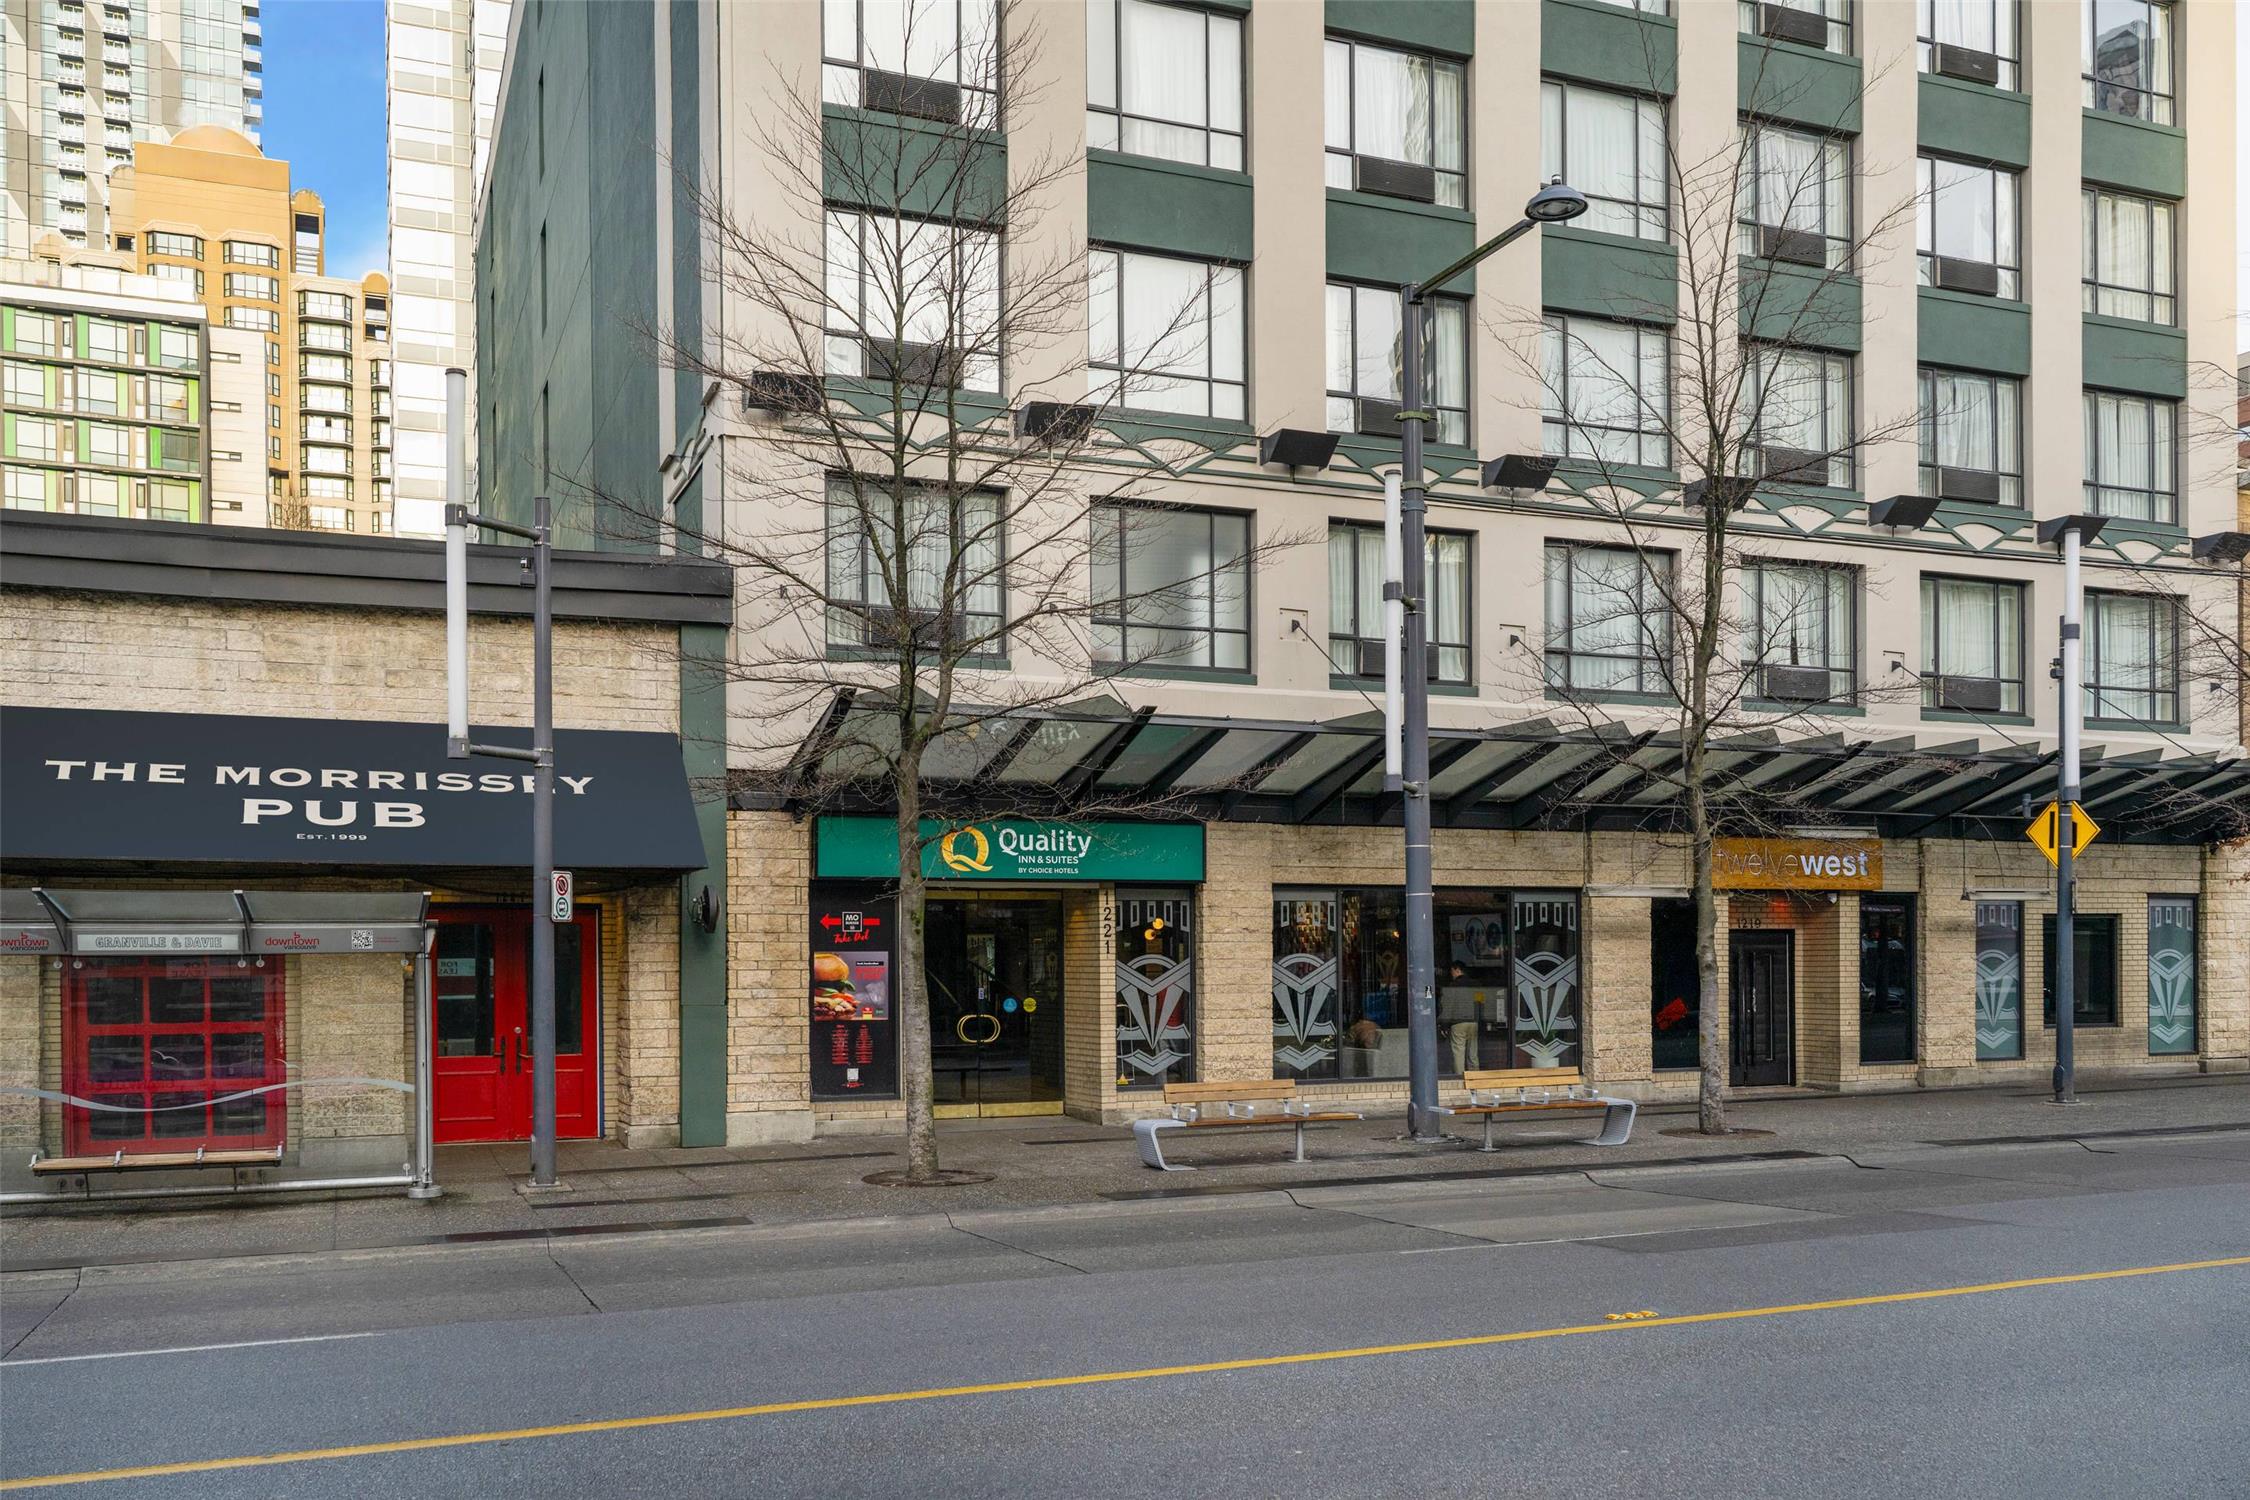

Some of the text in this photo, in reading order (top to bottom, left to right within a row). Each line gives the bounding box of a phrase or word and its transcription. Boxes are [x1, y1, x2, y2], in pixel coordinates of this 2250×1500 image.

[45, 760, 186, 784] THE
[240, 798, 426, 828] PUB
[998, 828, 1092, 858] Quality
[1018, 855, 1079, 865] INN & SUITES
[1028, 867, 1053, 875] CHOICE
[1054, 867, 1079, 875] HOTELS
[1103, 889, 1112, 955] 1221
[0, 932, 49, 947] owntown
[95, 936, 222, 948] GRANVILLE & DAVIE
[265, 932, 320, 946] downtown
